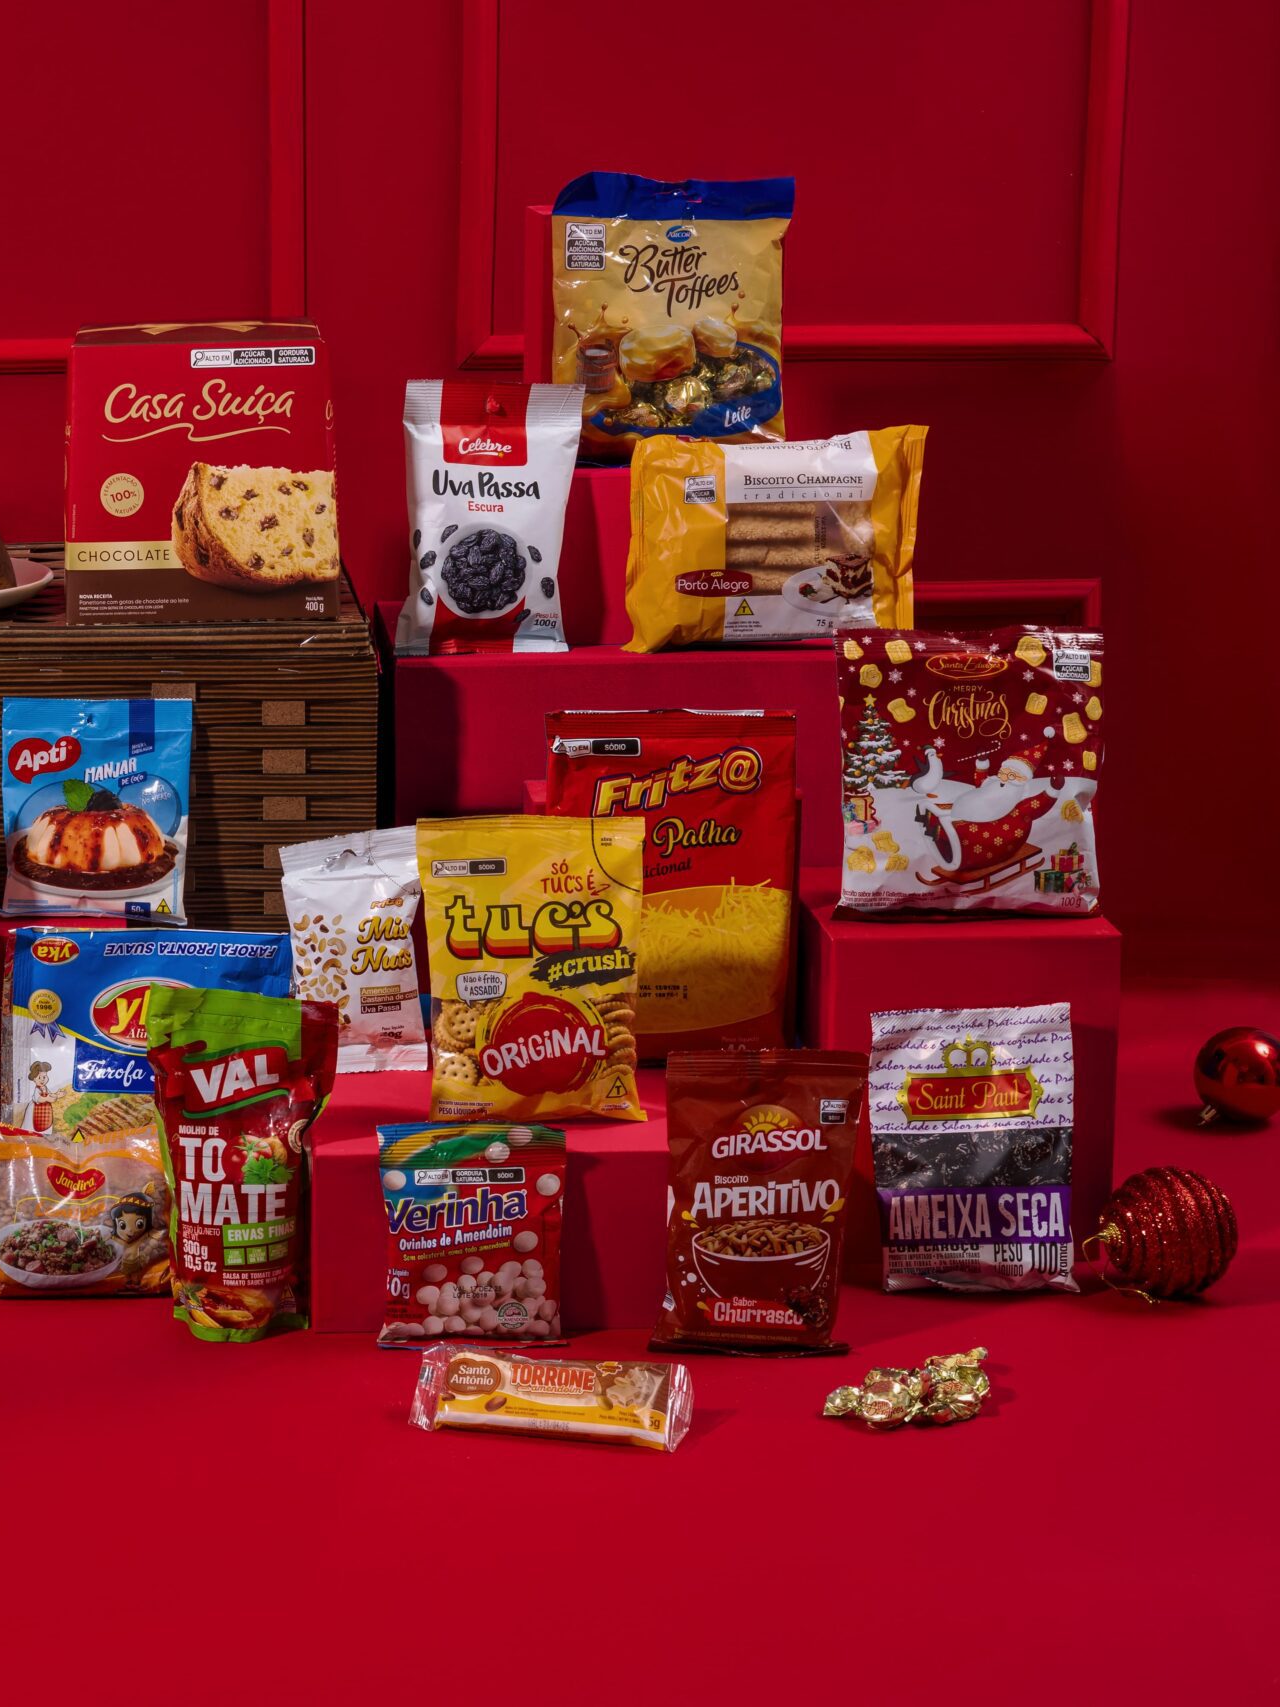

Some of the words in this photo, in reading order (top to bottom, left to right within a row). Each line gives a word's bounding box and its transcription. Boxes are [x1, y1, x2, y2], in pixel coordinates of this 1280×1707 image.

[619, 244, 706, 292] Butter
[654, 271, 739, 317] Toffees
[235, 356, 271, 365] ADICIONADO
[278, 356, 309, 364] SATURADA
[279, 349, 308, 357] GORDURA
[104, 383, 186, 423] Casa
[193, 379, 295, 424] Suíça
[724, 406, 752, 427] Leite
[458, 438, 512, 454] Celebre
[433, 470, 474, 498] Uva
[478, 471, 540, 499] Passa
[744, 474, 794, 486] BISCOITO
[797, 474, 863, 485] CHAMPAGNE
[110, 489, 137, 503] 100%
[744, 490, 863, 500] tradicional
[468, 501, 504, 513] Escura
[78, 549, 170, 562] CHOCOLATE
[678, 580, 708, 591] Porto
[711, 579, 749, 592] Alegre
[305, 602, 318, 611] 400
[319, 603, 324, 613] g
[534, 619, 557, 628] 100g
[1056, 670, 1088, 680] ADICIONADO
[1061, 665, 1084, 673] AÇÚCAR
[923, 691, 1012, 739] Christmas
[604, 742, 626, 751] SÓDIO
[15, 741, 67, 772] Apti
[84, 757, 137, 784] MANJAR
[121, 777, 130, 785] DE
[131, 775, 144, 784] COCO
[593, 746, 763, 816] Fritz@
[652, 818, 741, 856] Palha
[551, 859, 569, 874] SÓ
[541, 876, 582, 894] TUC'S
[586, 869, 594, 889] É
[357, 915, 410, 944] Mix
[36, 942, 71, 962] yka
[104, 942, 154, 956] SUAVE
[158, 942, 218, 956] PRONTA
[219, 943, 278, 958] FAROFA
[351, 945, 412, 975] Nuts
[547, 950, 630, 982] #crush
[361, 986, 400, 995] Amendoim
[470, 983, 500, 995] ASSADO!
[361, 995, 394, 1003] Castanha
[361, 1005, 376, 1014] Uva
[378, 1004, 400, 1012] Passa
[880, 1027, 906, 1037] Sabor
[946, 1020, 984, 1033] cozinha
[987, 1016, 1047, 1030] Praticidade
[79, 1060, 146, 1086] Farofa
[190, 1055, 279, 1104] VAL
[916, 1083, 966, 1110] Saint
[971, 1078, 1021, 1109] Paul
[179, 1125, 206, 1135] MOLHO
[208, 1126, 219, 1135] DE
[712, 1129, 827, 1159] GIRASSOL
[179, 1138, 227, 1182] TO
[56, 1172, 95, 1192] Jandira
[714, 1175, 749, 1184] BISCOITO
[181, 1183, 288, 1226] MATE
[691, 1179, 840, 1219] APERITIVO
[385, 1187, 527, 1234] Verinha
[889, 1193, 991, 1240] AMEIXA
[998, 1192, 1065, 1237] SECA
[228, 1229, 264, 1241] ERVAS
[269, 1221, 295, 1238] FINAS
[399, 1237, 437, 1251] Ovinhos
[440, 1234, 451, 1247] de
[455, 1224, 512, 1245] Amendoim
[183, 1239, 200, 1255] 300
[201, 1245, 208, 1260] g
[994, 1243, 1023, 1262] PESO
[1029, 1243, 1058, 1274] 100
[184, 1254, 201, 1271] 10,5
[994, 1263, 1023, 1277] LÍQUIDO
[733, 1297, 757, 1307] Sabor
[714, 1302, 803, 1325] Churrasco
[458, 1365, 490, 1375] Santo
[511, 1364, 595, 1391] TORRONE
[532, 1385, 583, 1394] amendoim
